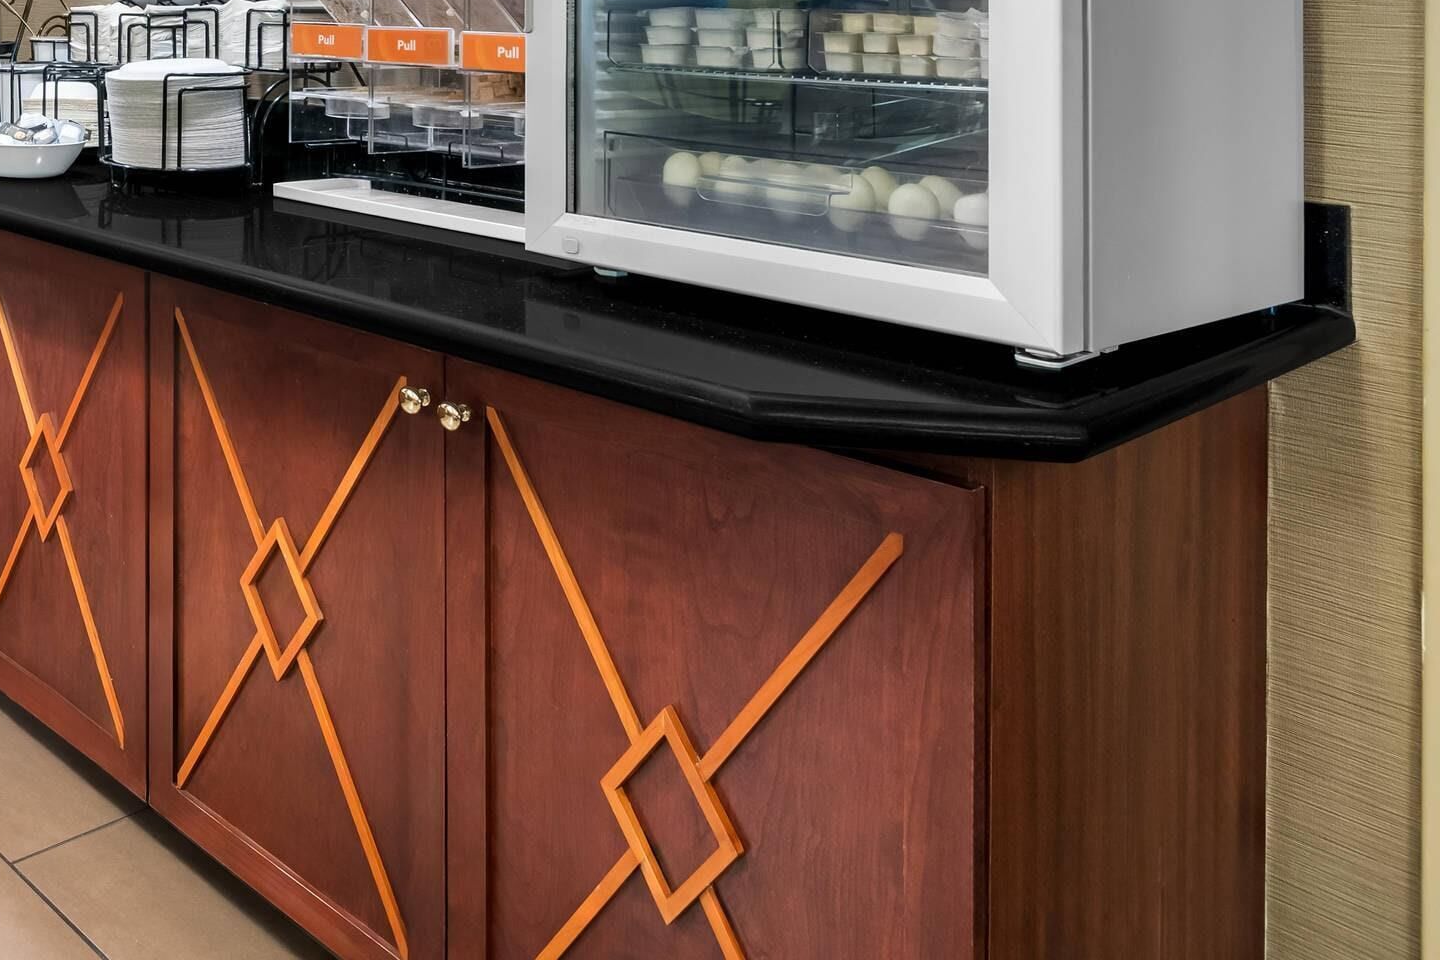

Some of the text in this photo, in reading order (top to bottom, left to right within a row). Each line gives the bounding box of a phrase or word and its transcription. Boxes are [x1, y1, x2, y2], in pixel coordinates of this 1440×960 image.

[317, 34, 335, 46] Pull
[397, 39, 416, 51] Pull
[497, 46, 520, 58] Pull
